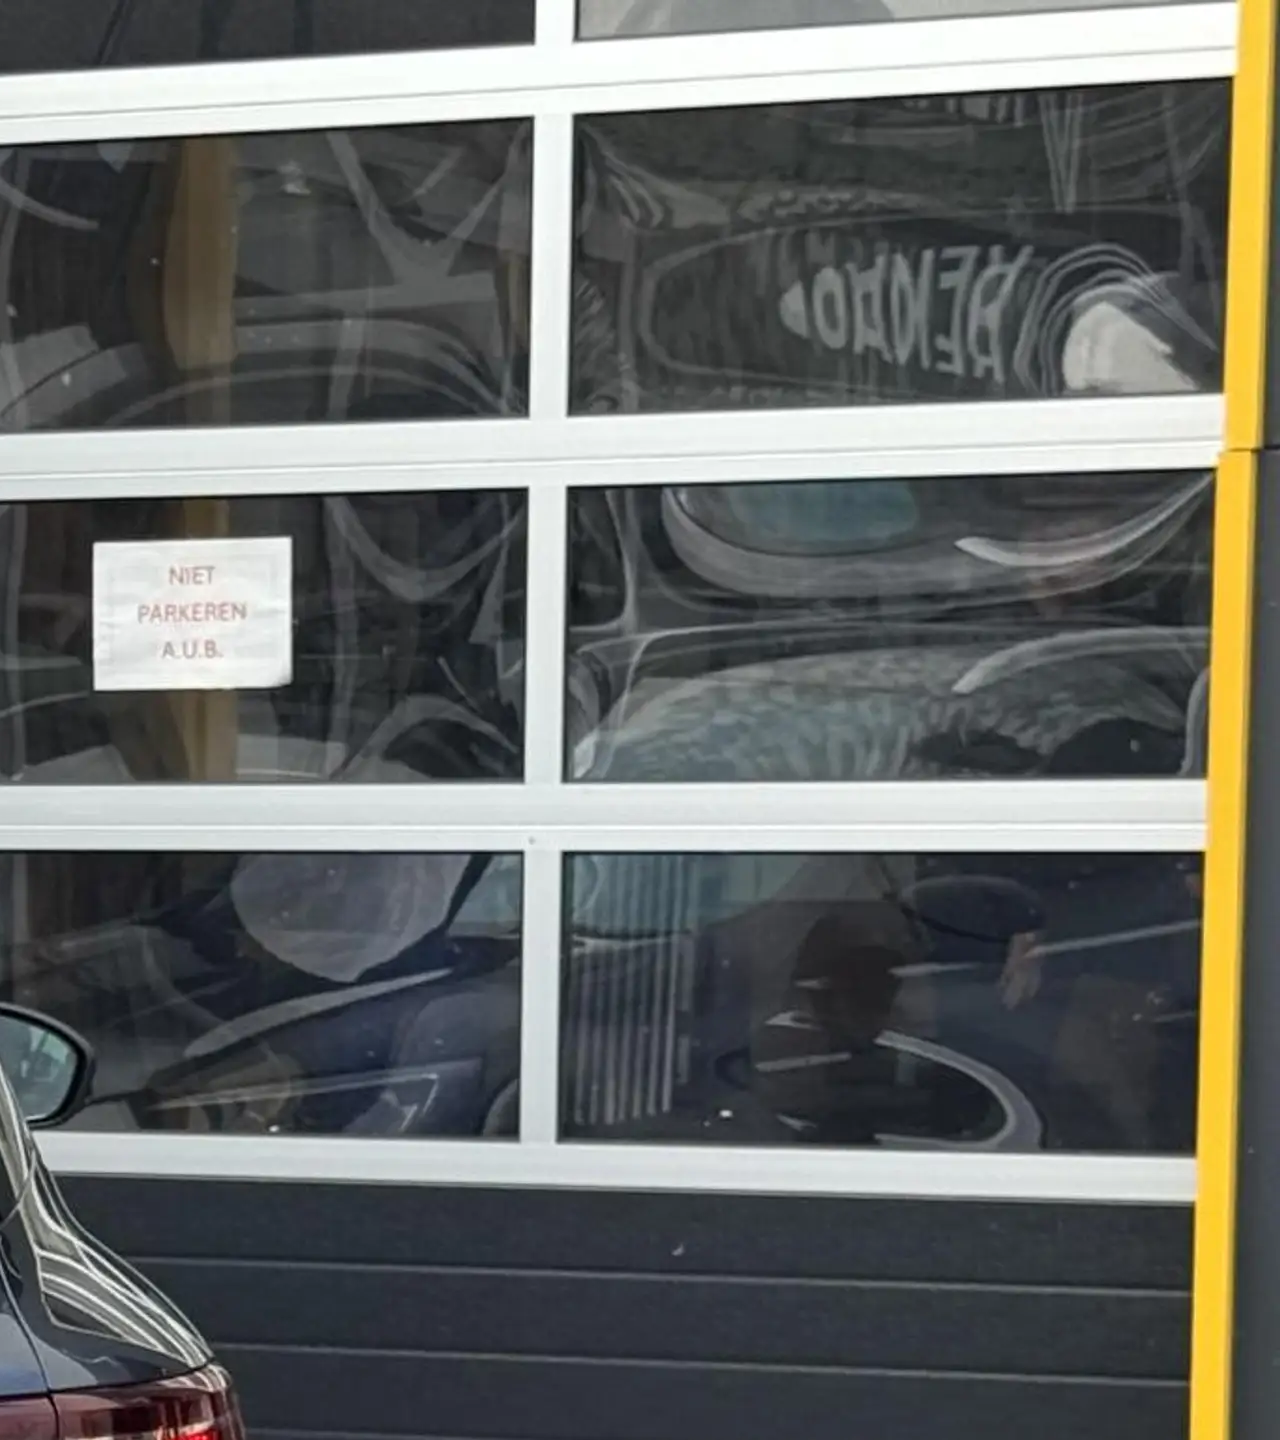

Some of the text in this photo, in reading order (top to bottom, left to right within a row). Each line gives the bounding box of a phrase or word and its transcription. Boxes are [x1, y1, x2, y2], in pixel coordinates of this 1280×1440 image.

[169, 565, 216, 585] NIET
[137, 602, 248, 624] PARKEREN
[161, 639, 223, 660] A.U.B.
